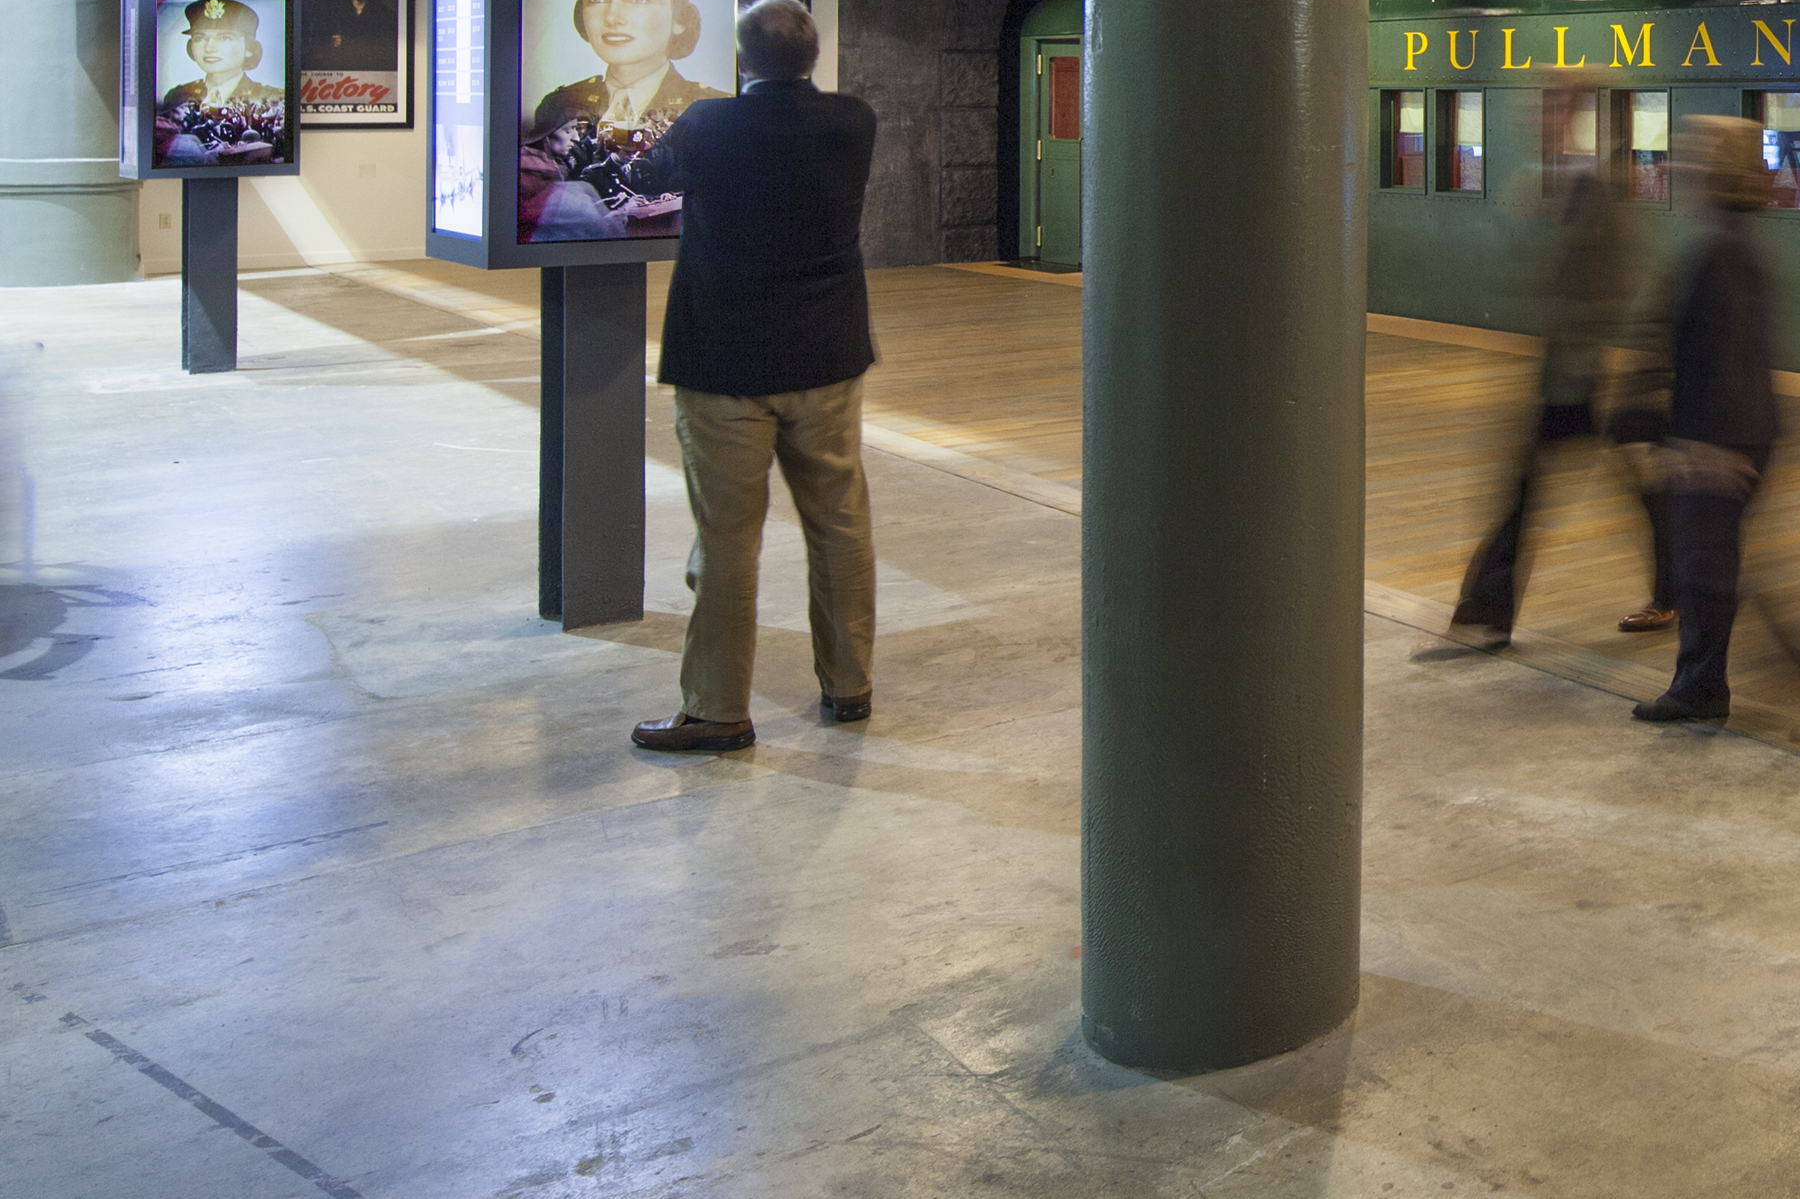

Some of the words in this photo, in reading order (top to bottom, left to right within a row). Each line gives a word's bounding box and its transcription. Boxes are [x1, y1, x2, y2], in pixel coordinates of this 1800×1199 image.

[1403, 19, 1797, 71] PULLMAN
[318, 105, 354, 113] COAST
[356, 105, 395, 113] GUARD
